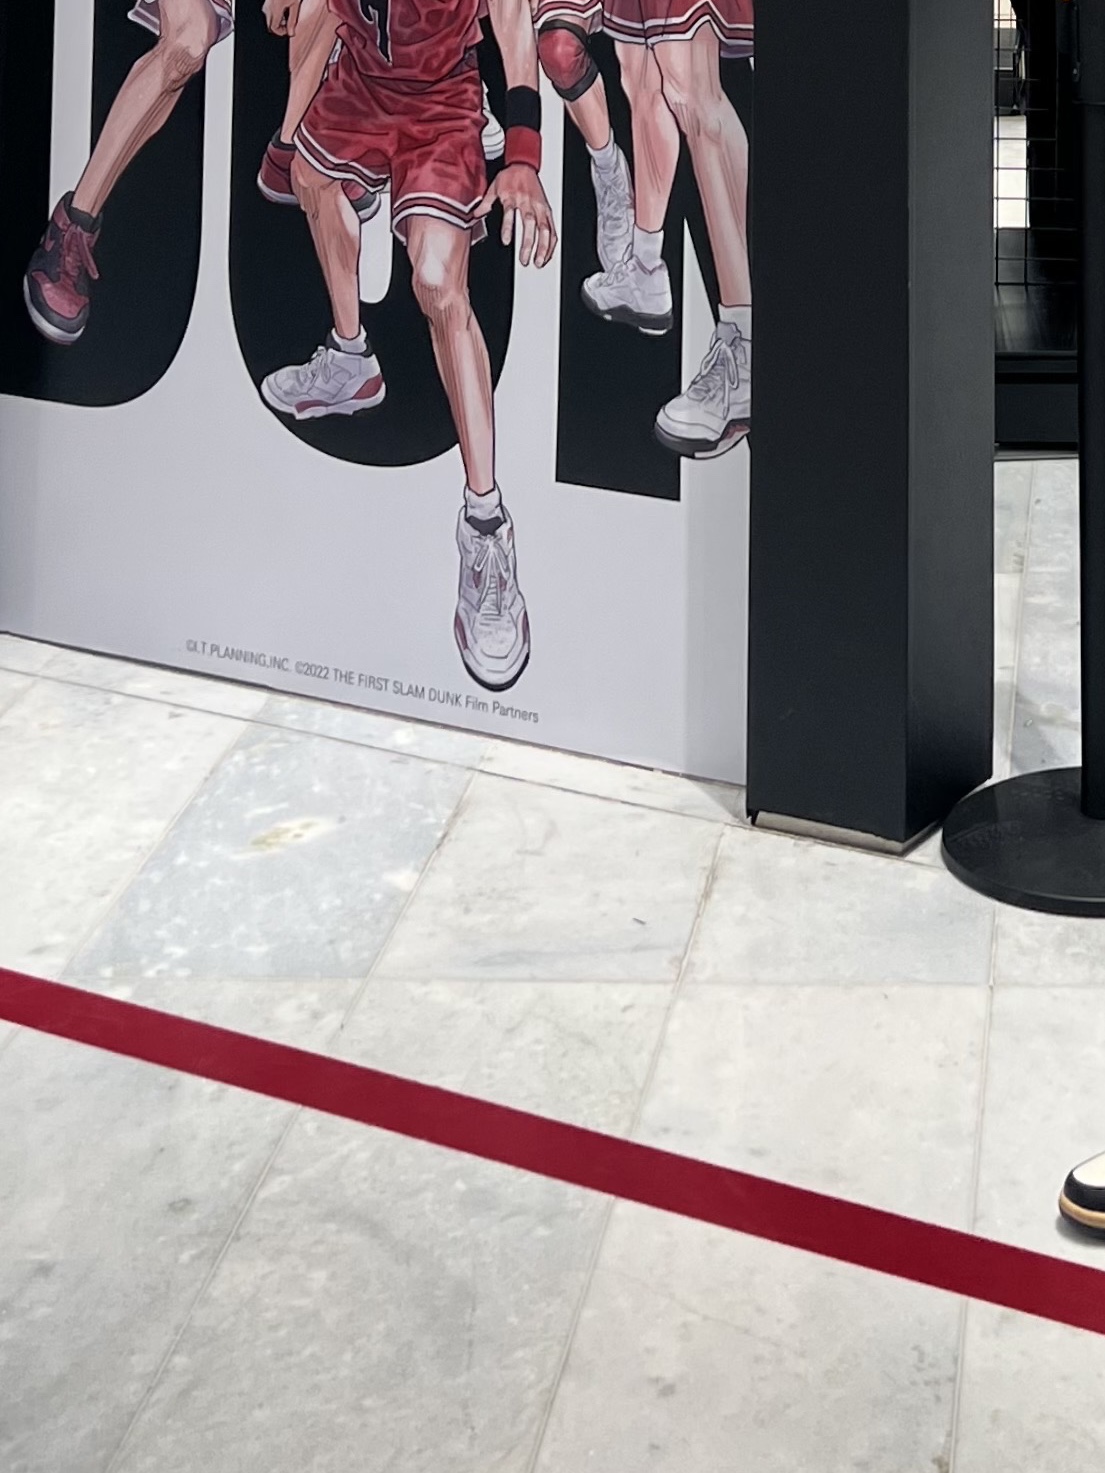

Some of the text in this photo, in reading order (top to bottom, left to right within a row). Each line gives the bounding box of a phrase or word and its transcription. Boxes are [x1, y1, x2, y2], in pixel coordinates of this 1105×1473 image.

[333, 668, 355, 684] THE
[358, 673, 390, 693] FIRST
[392, 681, 425, 700] SLAM
[428, 687, 463, 708] DUNK
[465, 694, 489, 714] Film
[492, 700, 540, 725] Partners
